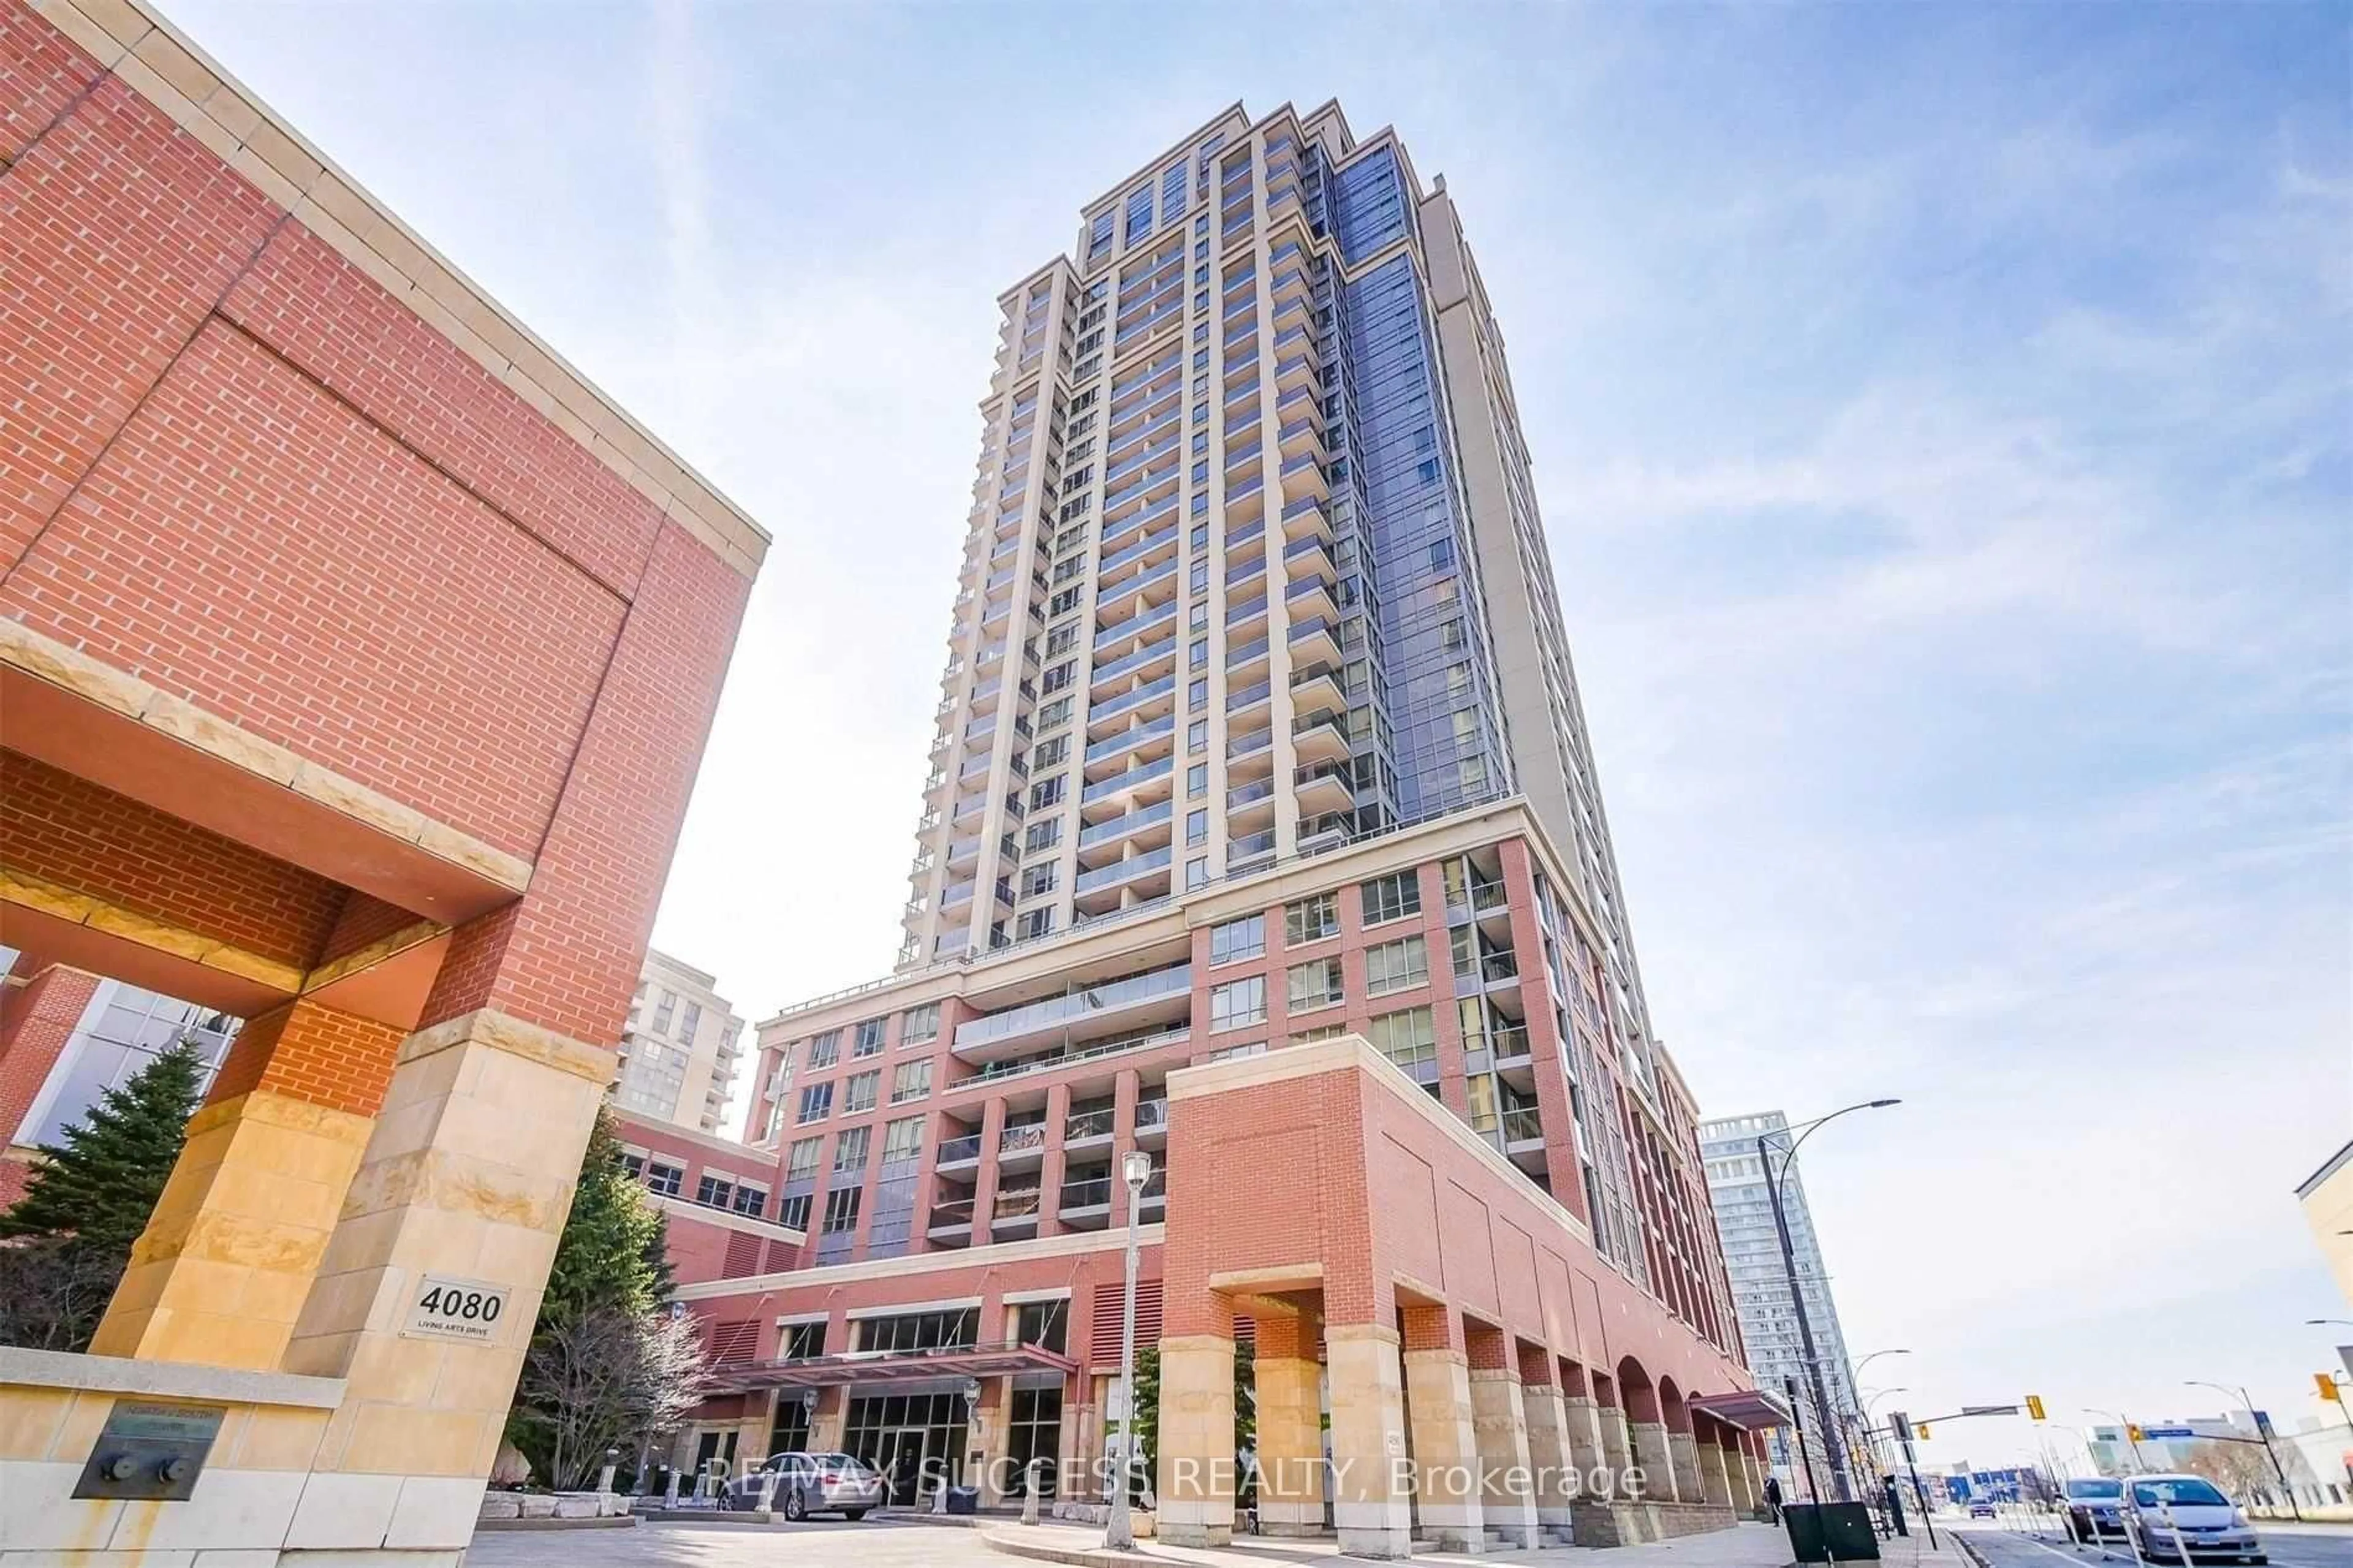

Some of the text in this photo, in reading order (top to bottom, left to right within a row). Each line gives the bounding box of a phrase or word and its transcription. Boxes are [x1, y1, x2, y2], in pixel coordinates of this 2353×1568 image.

[420, 1287, 501, 1321] 4080
[418, 1320, 488, 1336] LIVING ARTS DRIVE
